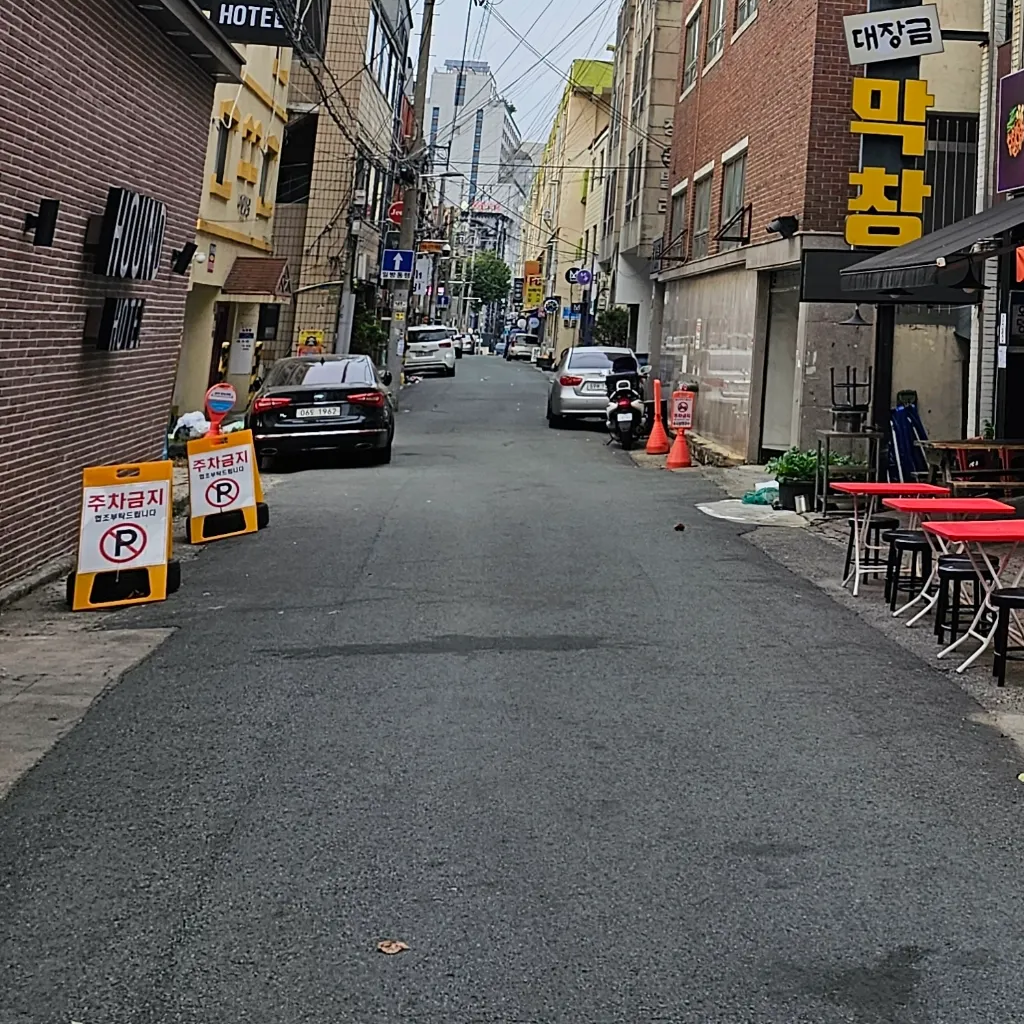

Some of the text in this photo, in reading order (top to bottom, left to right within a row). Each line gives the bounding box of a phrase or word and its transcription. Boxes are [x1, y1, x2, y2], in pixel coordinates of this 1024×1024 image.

[851, 17, 933, 52] 대장금
[845, 76, 935, 248] 막창
[106, 188, 167, 280] HOUND
[192, 450, 249, 473] 주차금지
[87, 488, 164, 513] 주차금지
